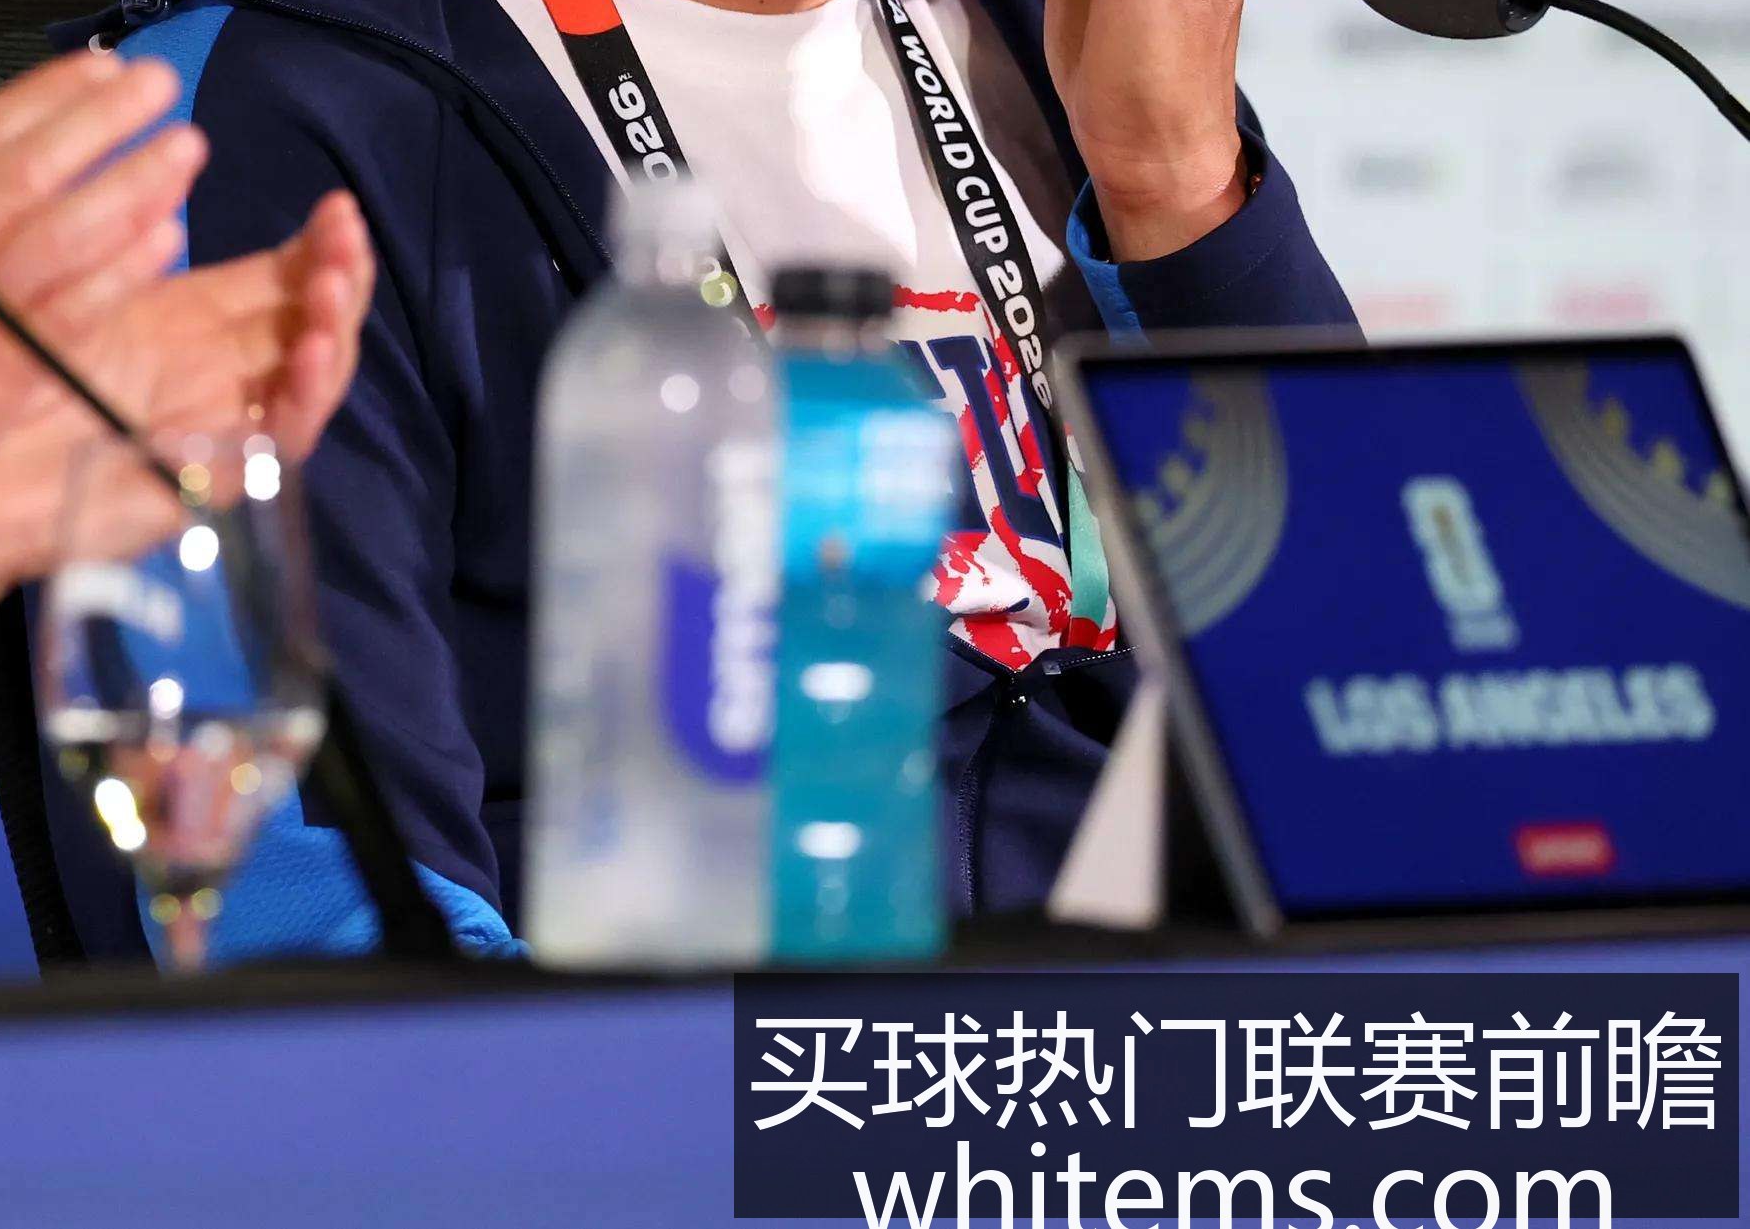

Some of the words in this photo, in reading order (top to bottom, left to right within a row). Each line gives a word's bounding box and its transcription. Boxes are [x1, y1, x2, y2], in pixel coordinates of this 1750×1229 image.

[901, 34, 976, 170] WORLD
[956, 175, 1009, 254] CUP
[986, 259, 1053, 410] 2026
